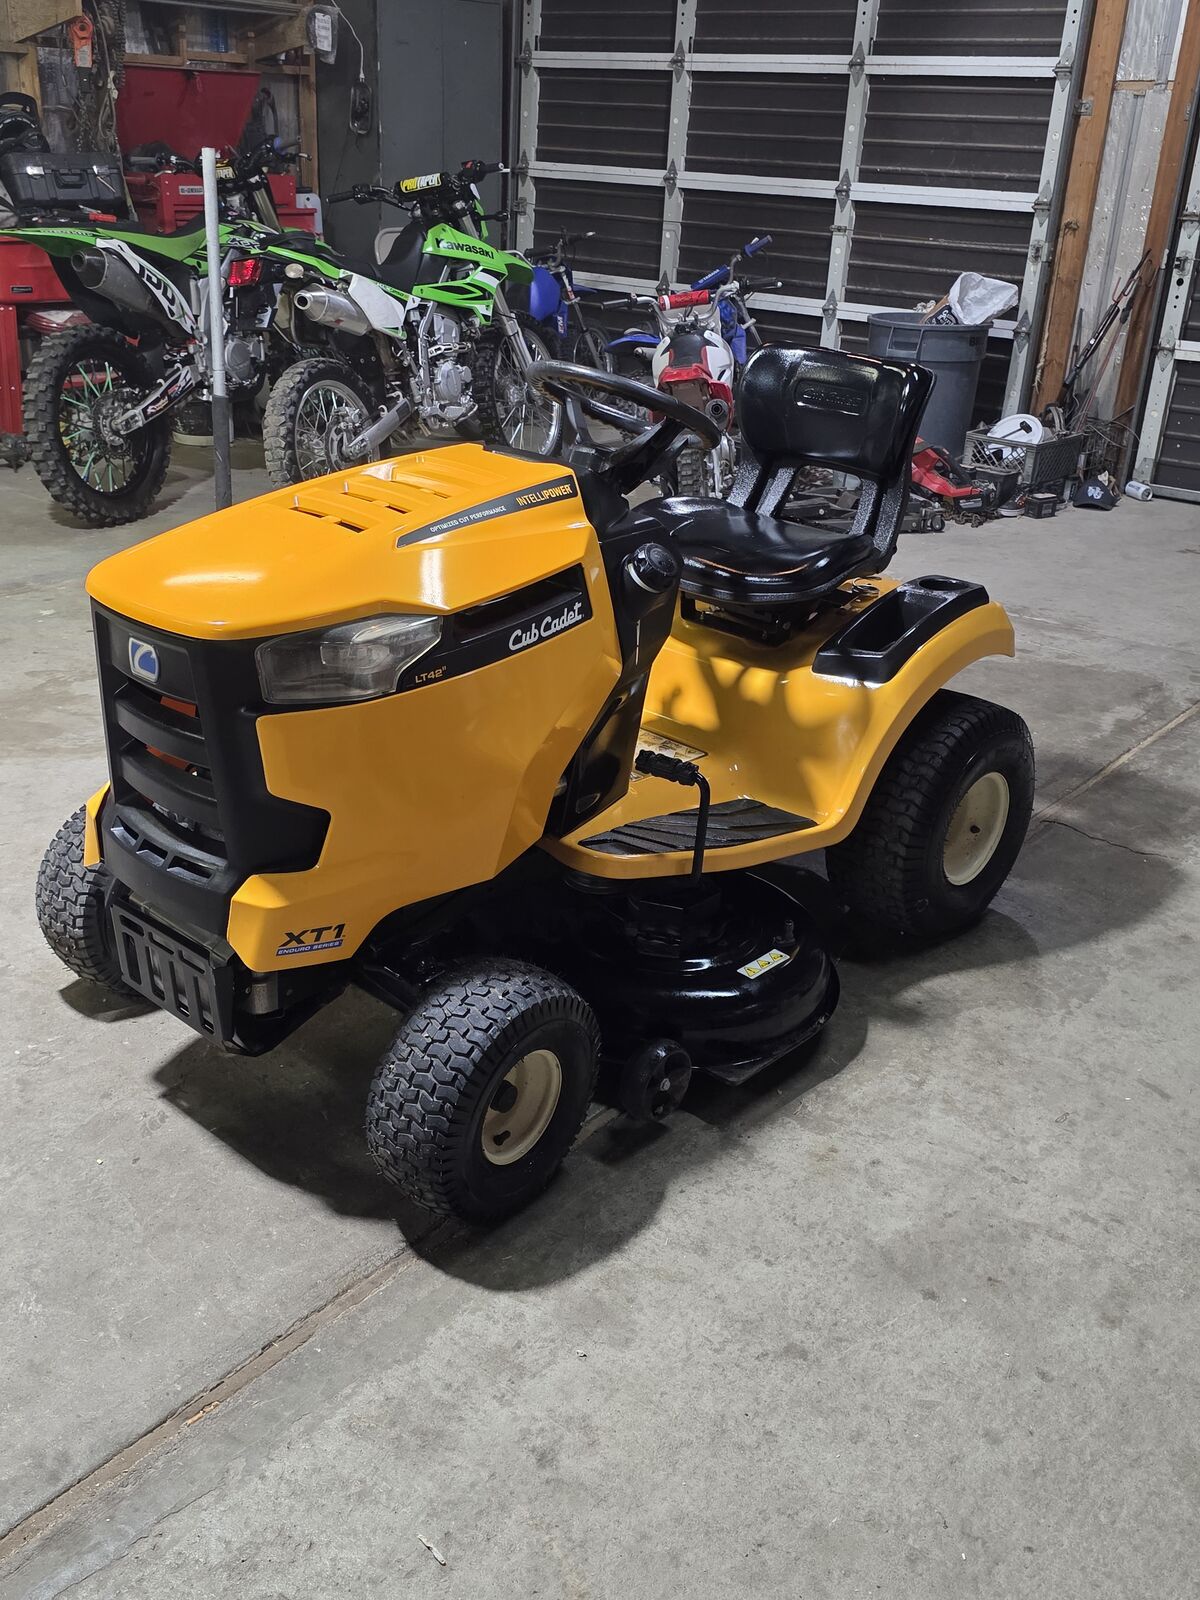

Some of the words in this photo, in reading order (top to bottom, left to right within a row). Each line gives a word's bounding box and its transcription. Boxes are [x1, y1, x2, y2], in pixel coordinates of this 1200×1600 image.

[435, 238, 494, 259] Kawasaki
[516, 484, 573, 506] INTELLIPOWER
[430, 520, 459, 533] OPTIMIZED
[470, 505, 506, 521] PERFORMANCE
[509, 623, 539, 650] Cub
[540, 602, 582, 638] Cadet
[279, 923, 346, 947] XT1
[278, 945, 310, 955] ENDURO
[312, 941, 340, 950] SERIES
